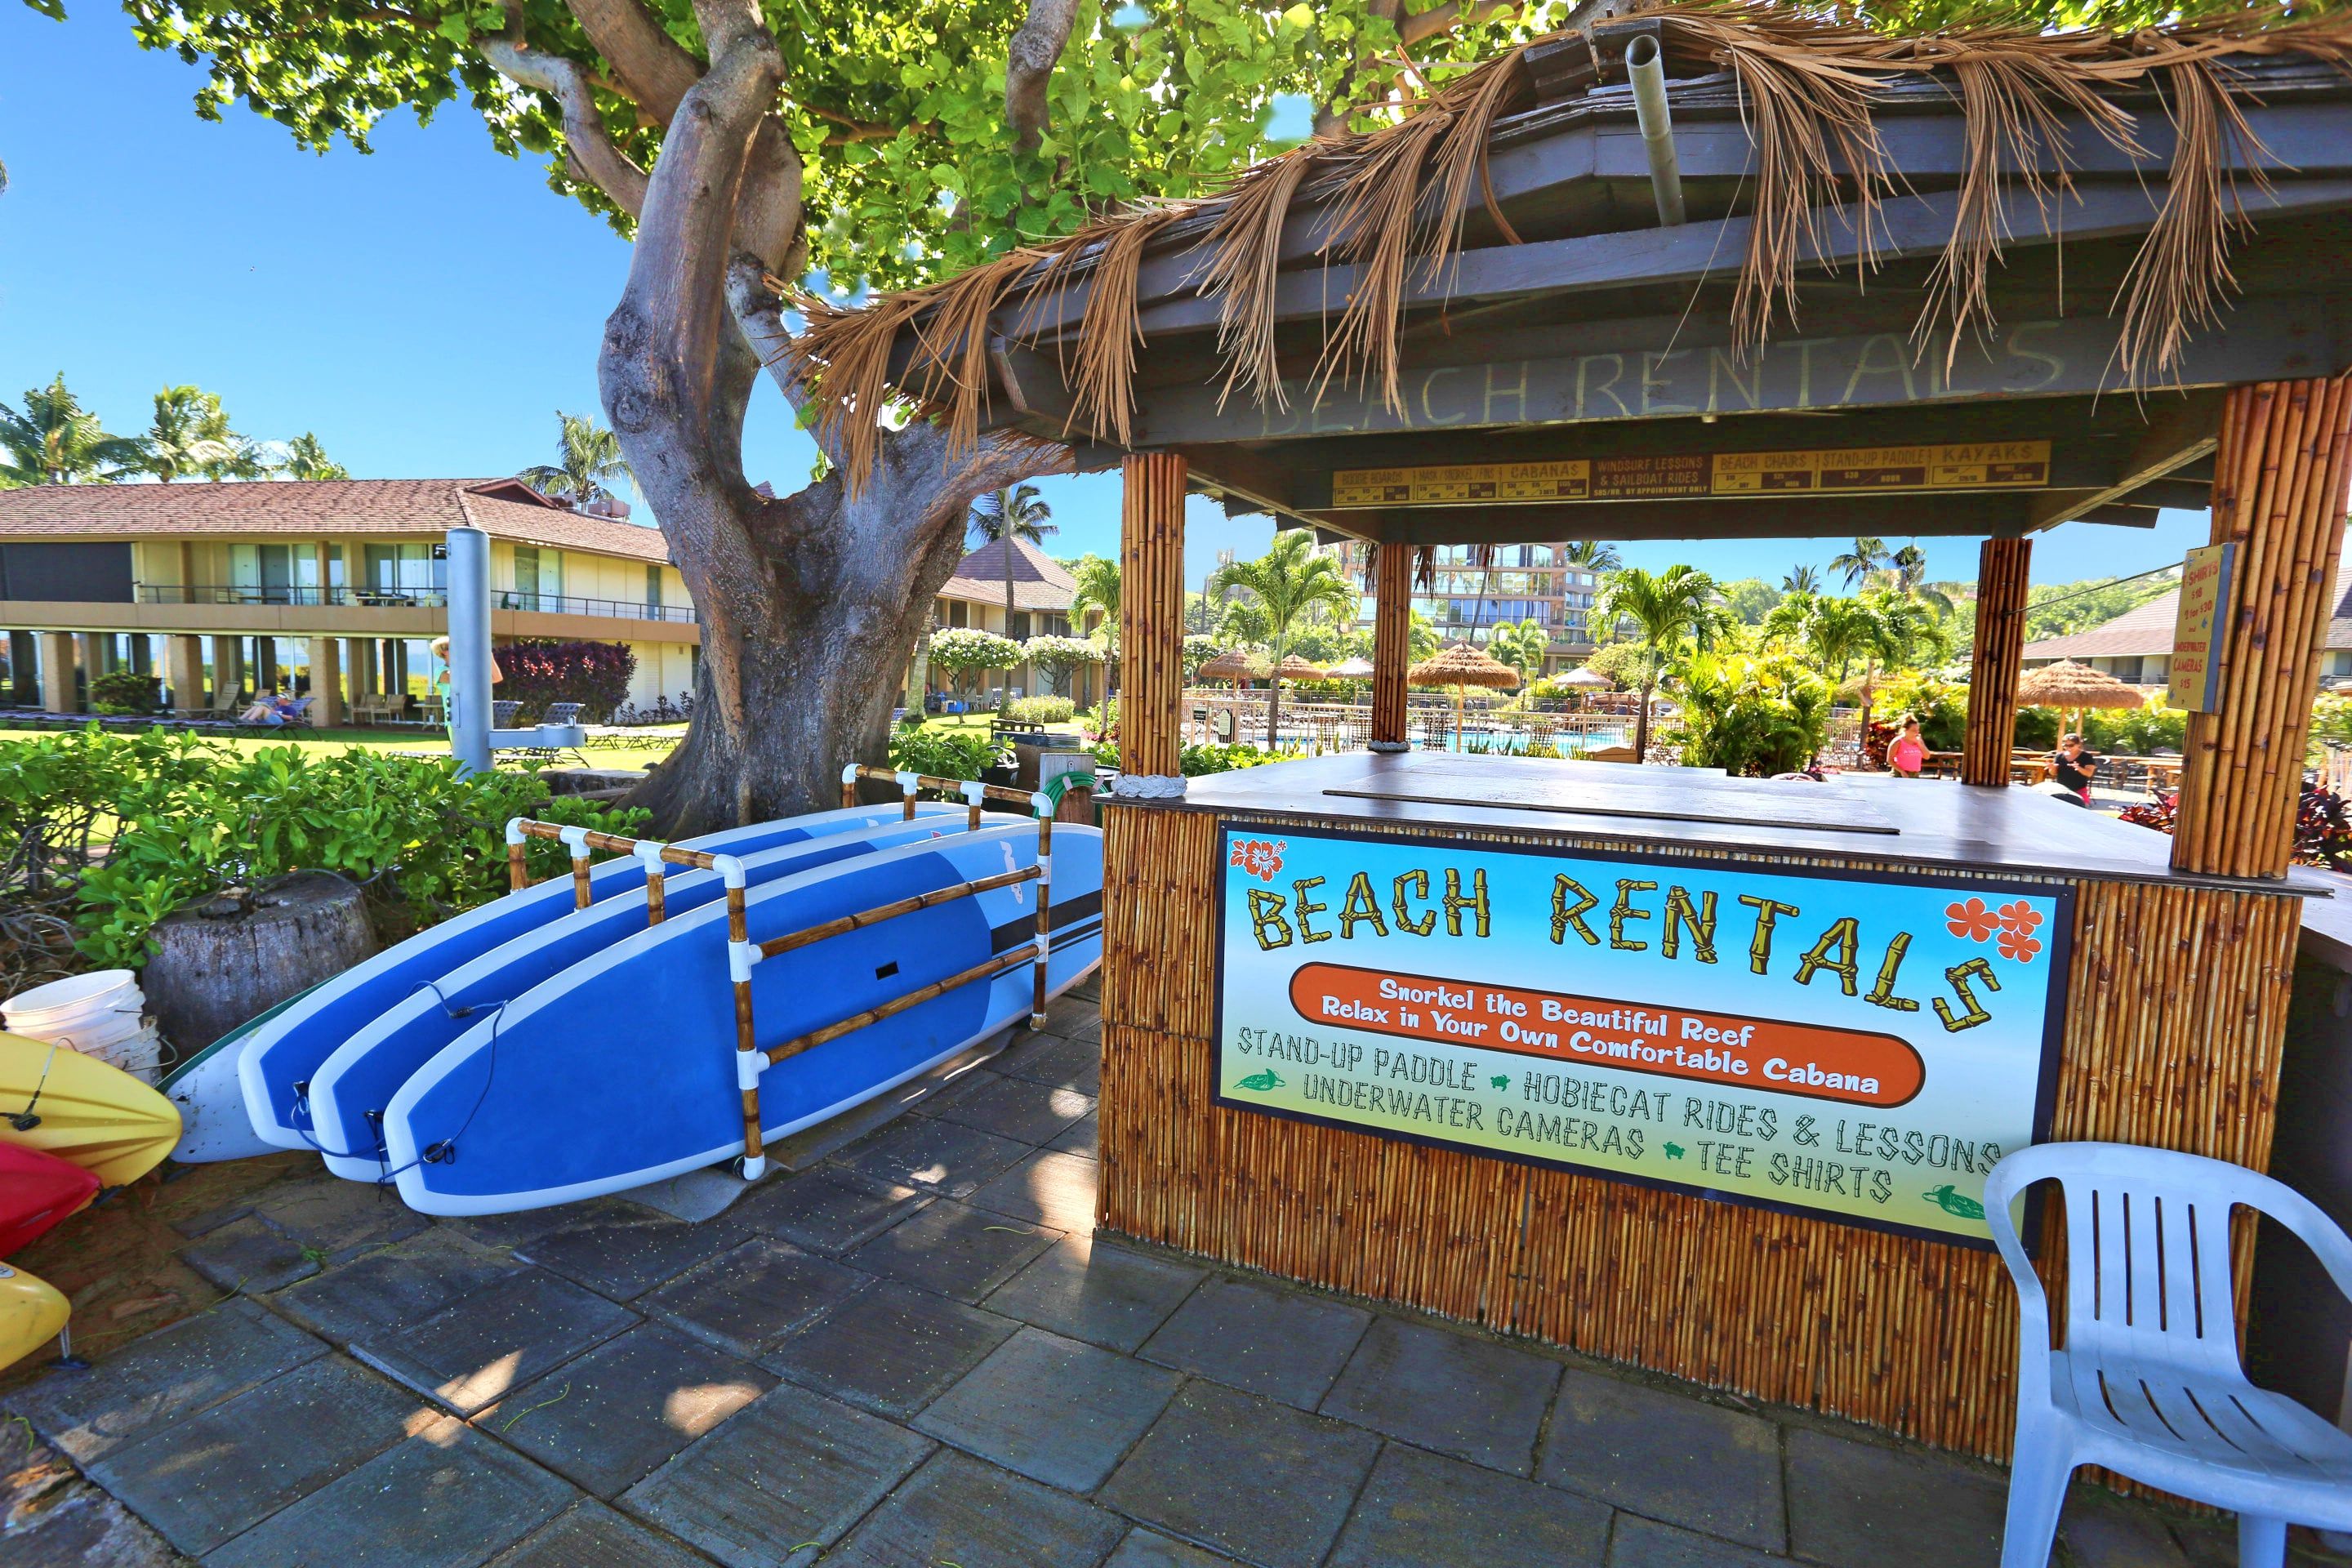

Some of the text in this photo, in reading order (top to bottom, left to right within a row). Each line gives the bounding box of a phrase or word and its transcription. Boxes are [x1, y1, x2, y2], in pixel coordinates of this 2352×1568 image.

[1262, 321, 2065, 436] BEACH RENTALS
[1823, 448, 1925, 468] STAND-UP PADDLE
[1942, 444, 2033, 462] KAYAKS
[1597, 457, 1704, 472] WINDSURF LESSONS
[1721, 453, 1807, 470] BEACH CHAIRS
[1371, 470, 1403, 483] BOARDS
[1419, 469, 1437, 482] MASK
[1510, 463, 1579, 479] CABANAS
[1600, 471, 1699, 486] & SAILBOAT RIDES
[1637, 486, 1686, 494] APPOINTMENT
[2185, 609, 2189, 620] 2
[2189, 608, 2198, 618] for
[2175, 641, 2207, 653] UNDERWATER
[2174, 657, 2203, 673] CAMERAS
[1248, 868, 2002, 1033] BEACH RENTALS
[1379, 978, 1755, 1048] Snorkel the Beautiful Reef
[1322, 996, 1879, 1094] Relax in Your Own Comfortable Cabana
[1237, 1027, 2001, 1177] STAND-UP PADDLE HOBIECAT RIDES & LESSONS
[1303, 1074, 1891, 1204] UNDERWATER CAMERAS TEE SHIRTS
